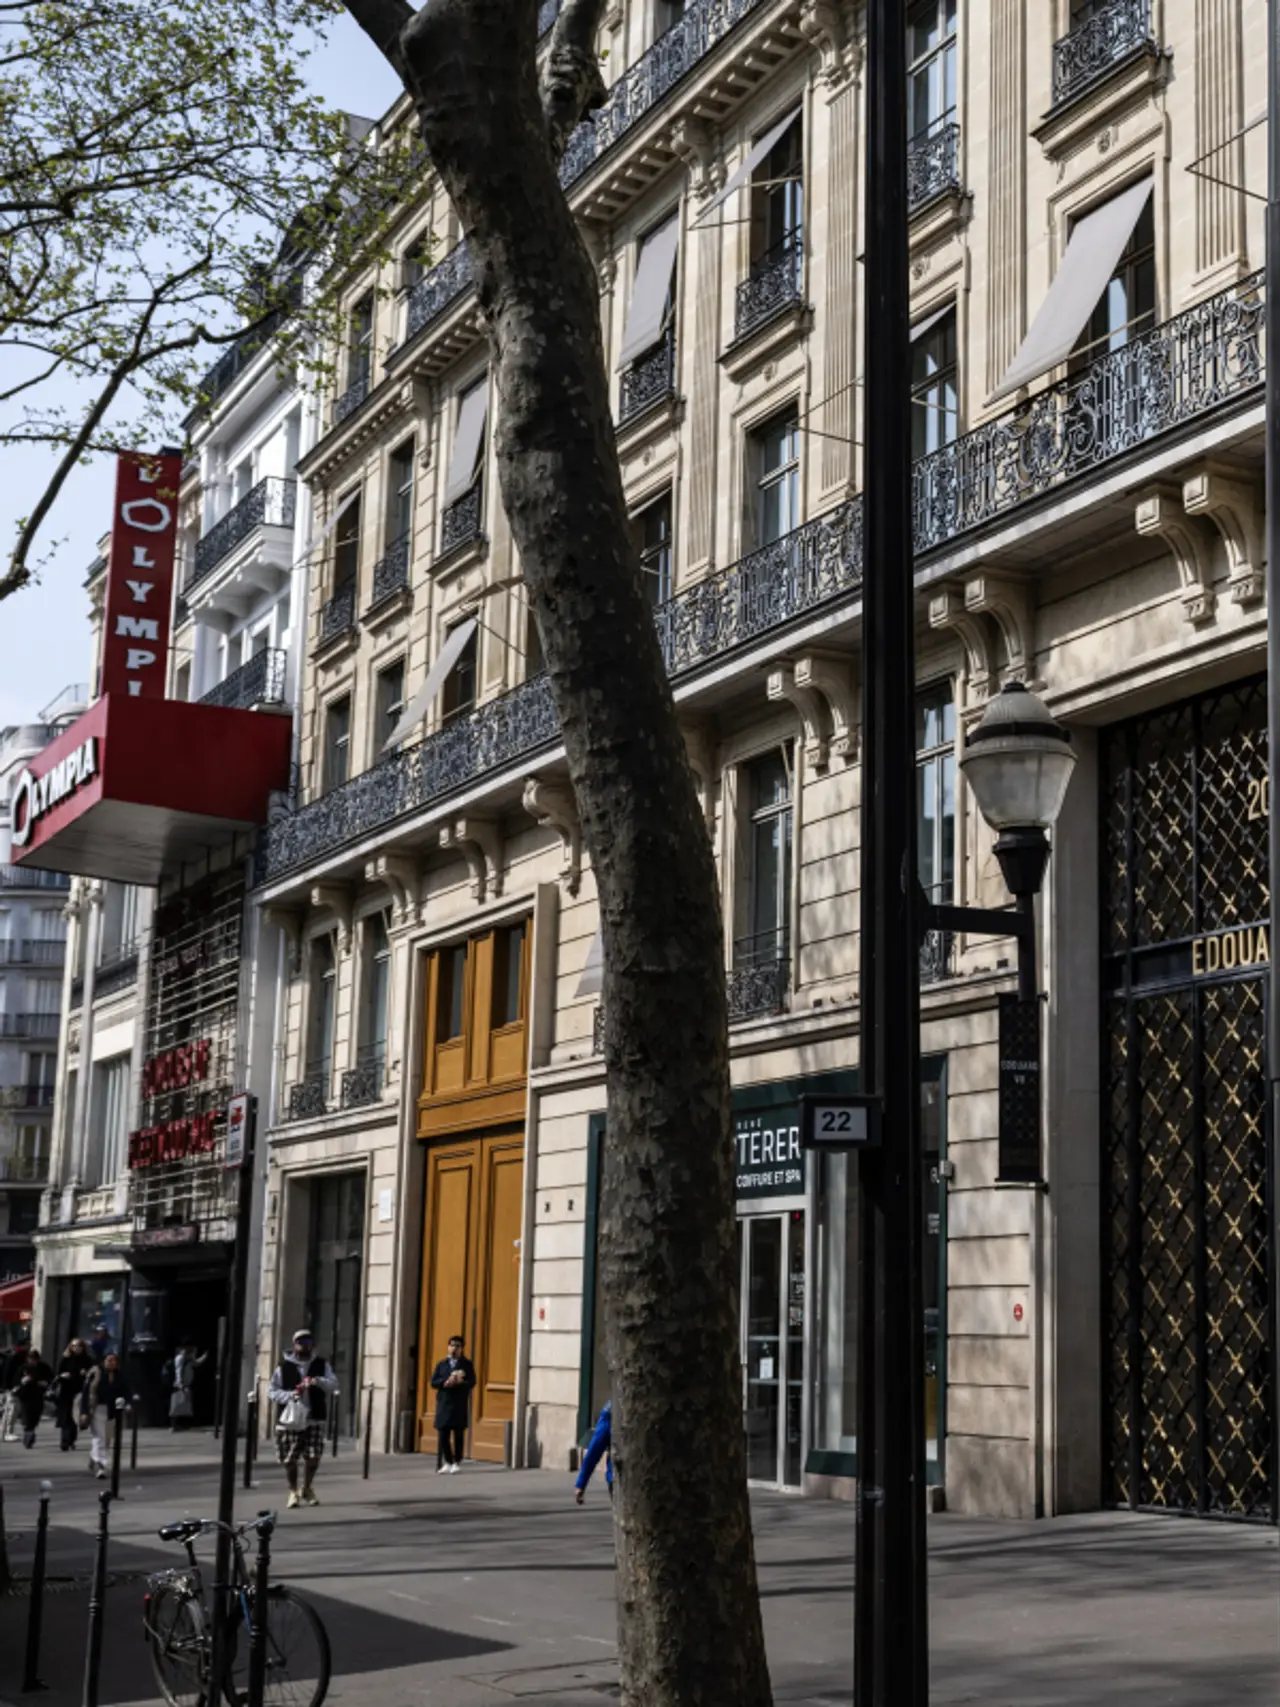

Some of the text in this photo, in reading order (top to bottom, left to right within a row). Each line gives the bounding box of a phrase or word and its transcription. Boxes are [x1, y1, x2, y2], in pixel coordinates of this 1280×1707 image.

[11, 737, 97, 847] OLYMPIA
[821, 1111, 852, 1133] 22
[733, 1126, 802, 1167] TERER
[736, 1171, 773, 1188] COIFFURE
[774, 1170, 784, 1185] ET
